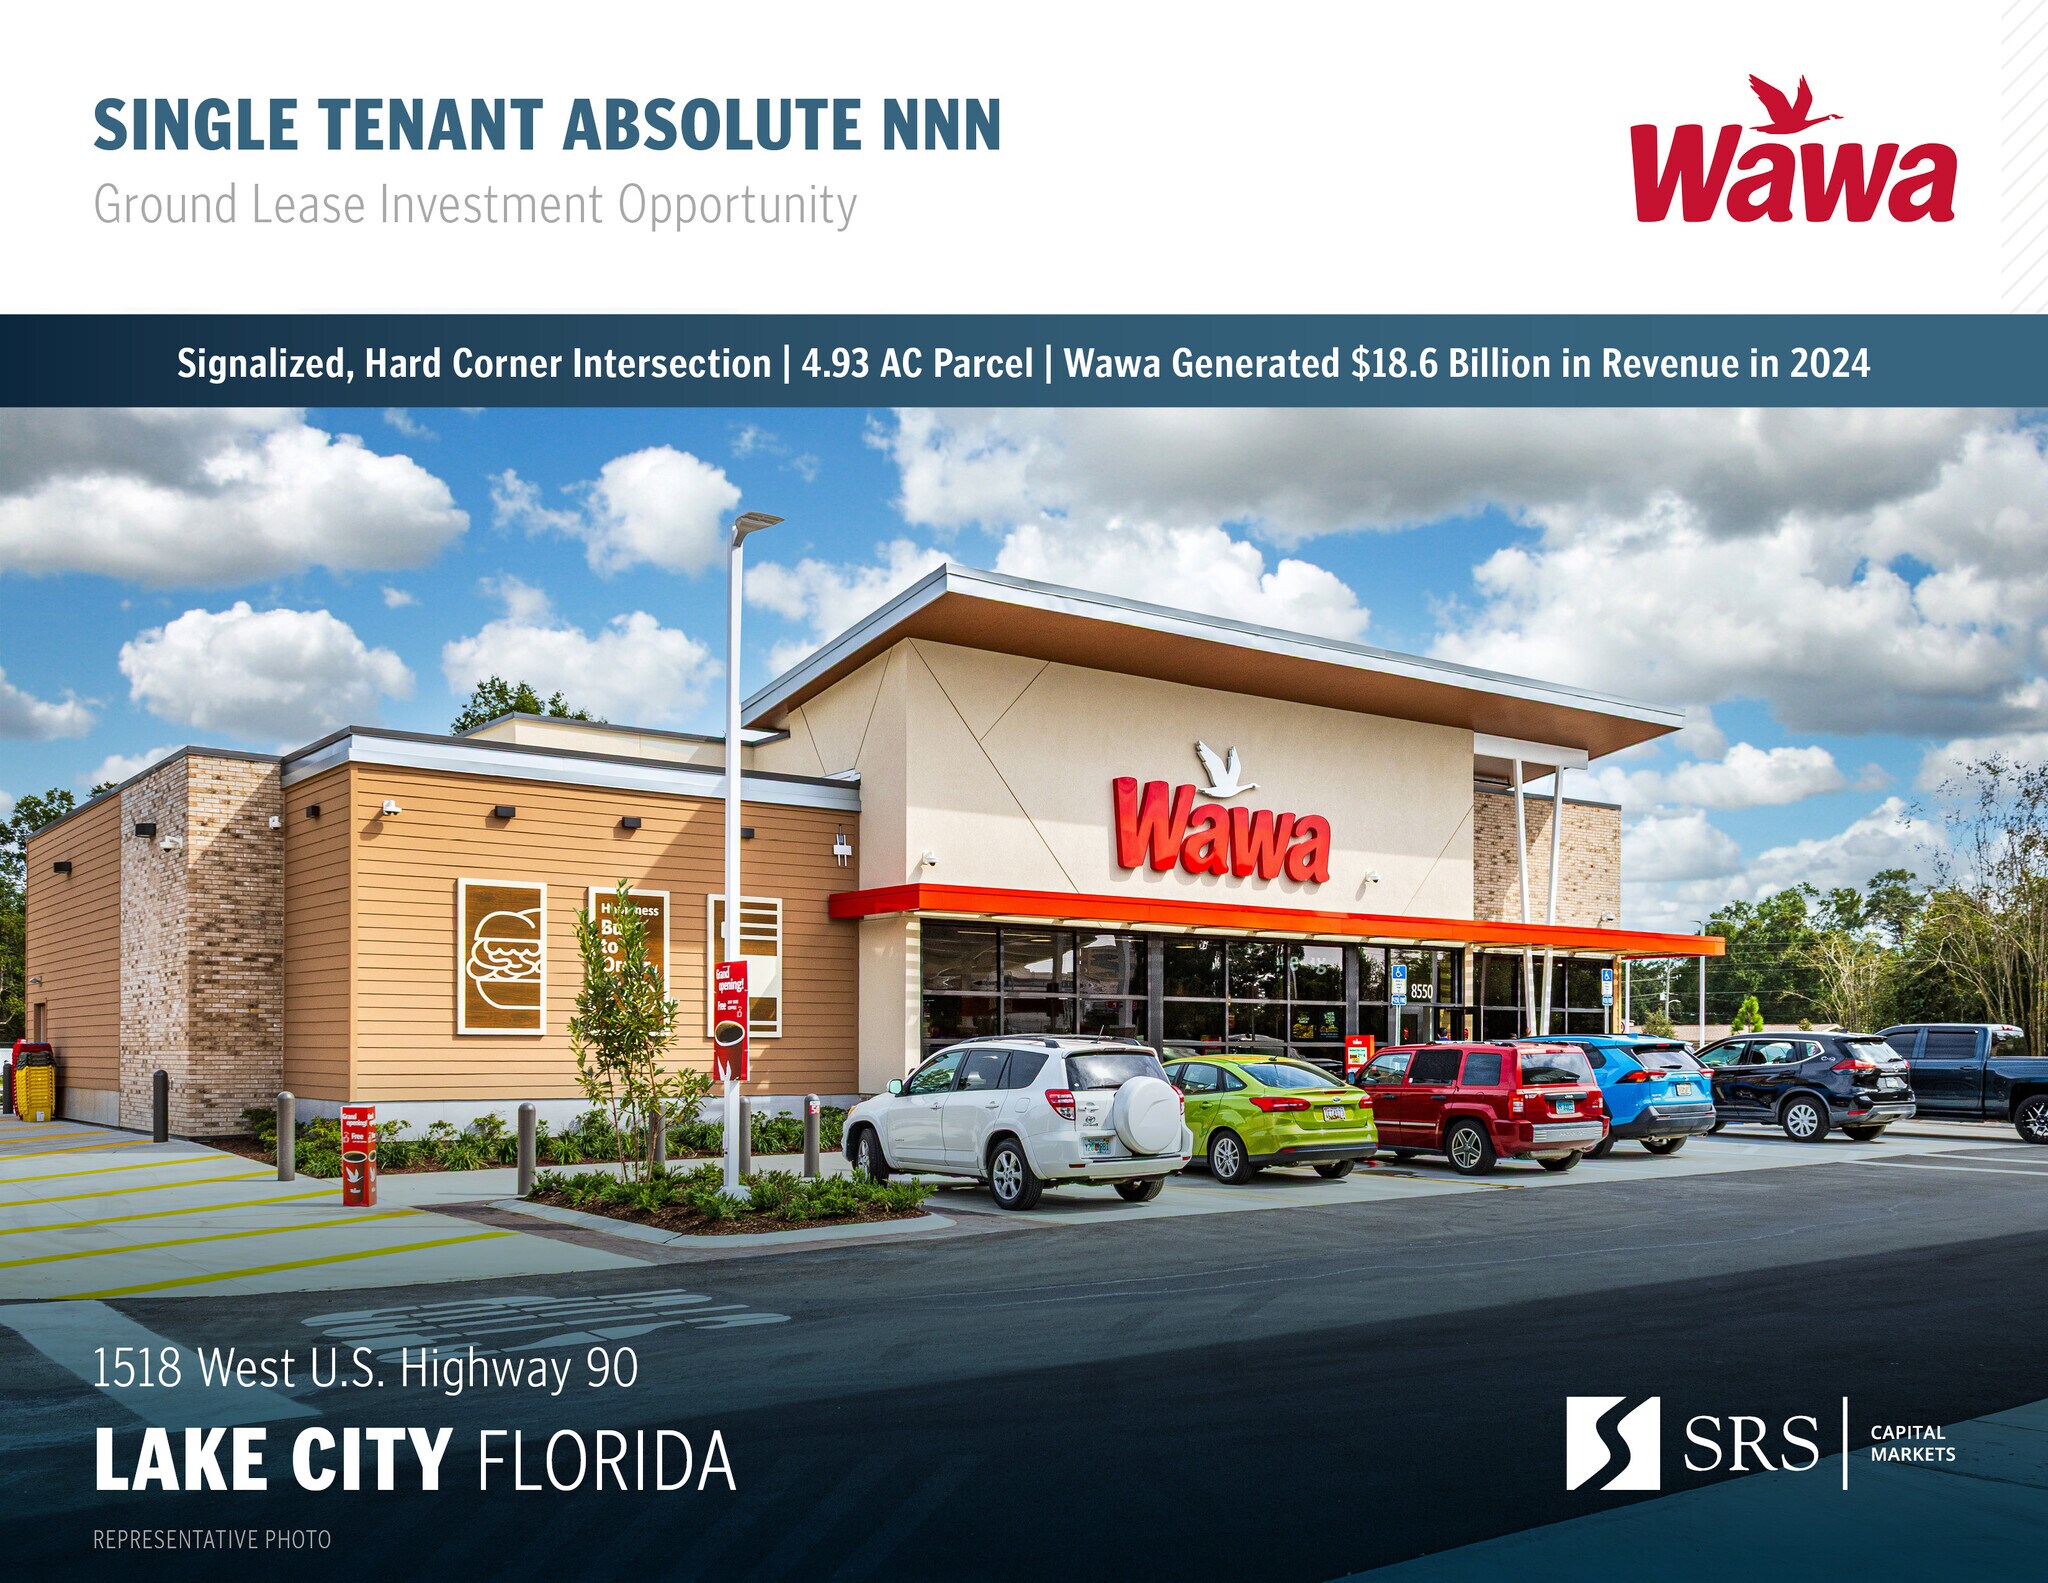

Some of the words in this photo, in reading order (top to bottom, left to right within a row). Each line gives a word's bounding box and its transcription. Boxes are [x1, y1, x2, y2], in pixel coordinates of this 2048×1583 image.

[1112, 777, 1331, 883] Wawa
[716, 966, 731, 980] Grand
[718, 978, 744, 994] opening!
[1411, 984, 1434, 999] 8550
[717, 1001, 727, 1011] Free
